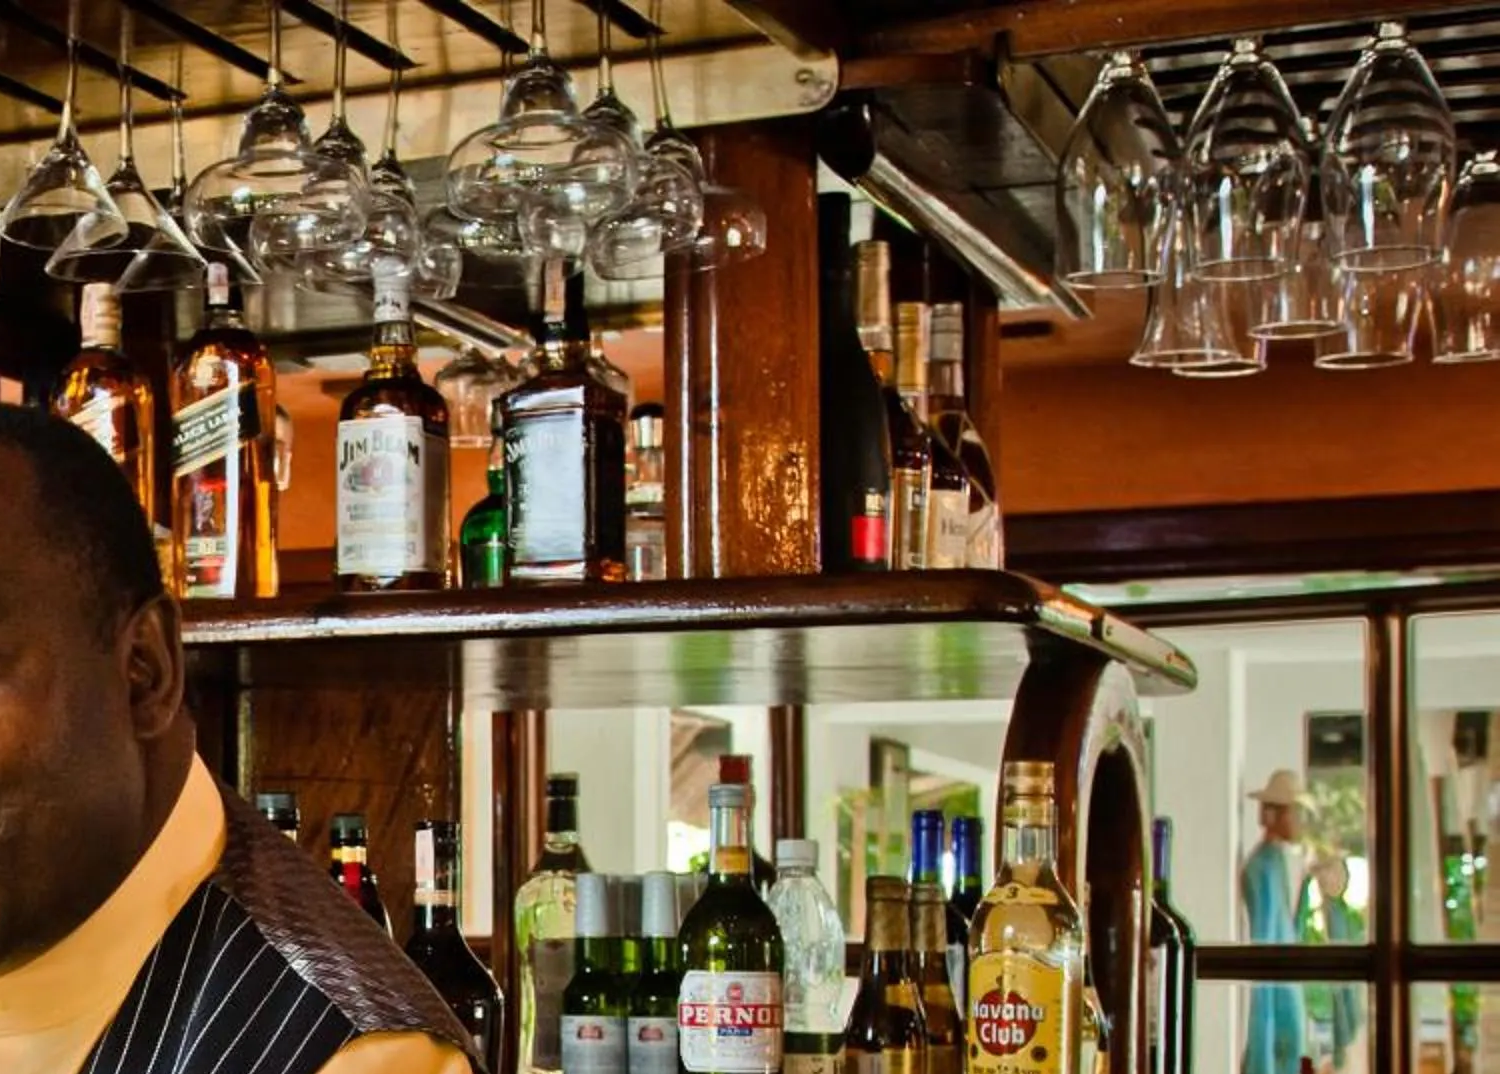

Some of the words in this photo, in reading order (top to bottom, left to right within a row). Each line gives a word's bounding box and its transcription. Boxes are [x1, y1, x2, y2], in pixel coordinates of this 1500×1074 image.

[340, 437, 368, 471] JIM
[372, 429, 420, 466] BEAM
[972, 1000, 1046, 1023] Havana
[980, 1022, 1026, 1046] Club
